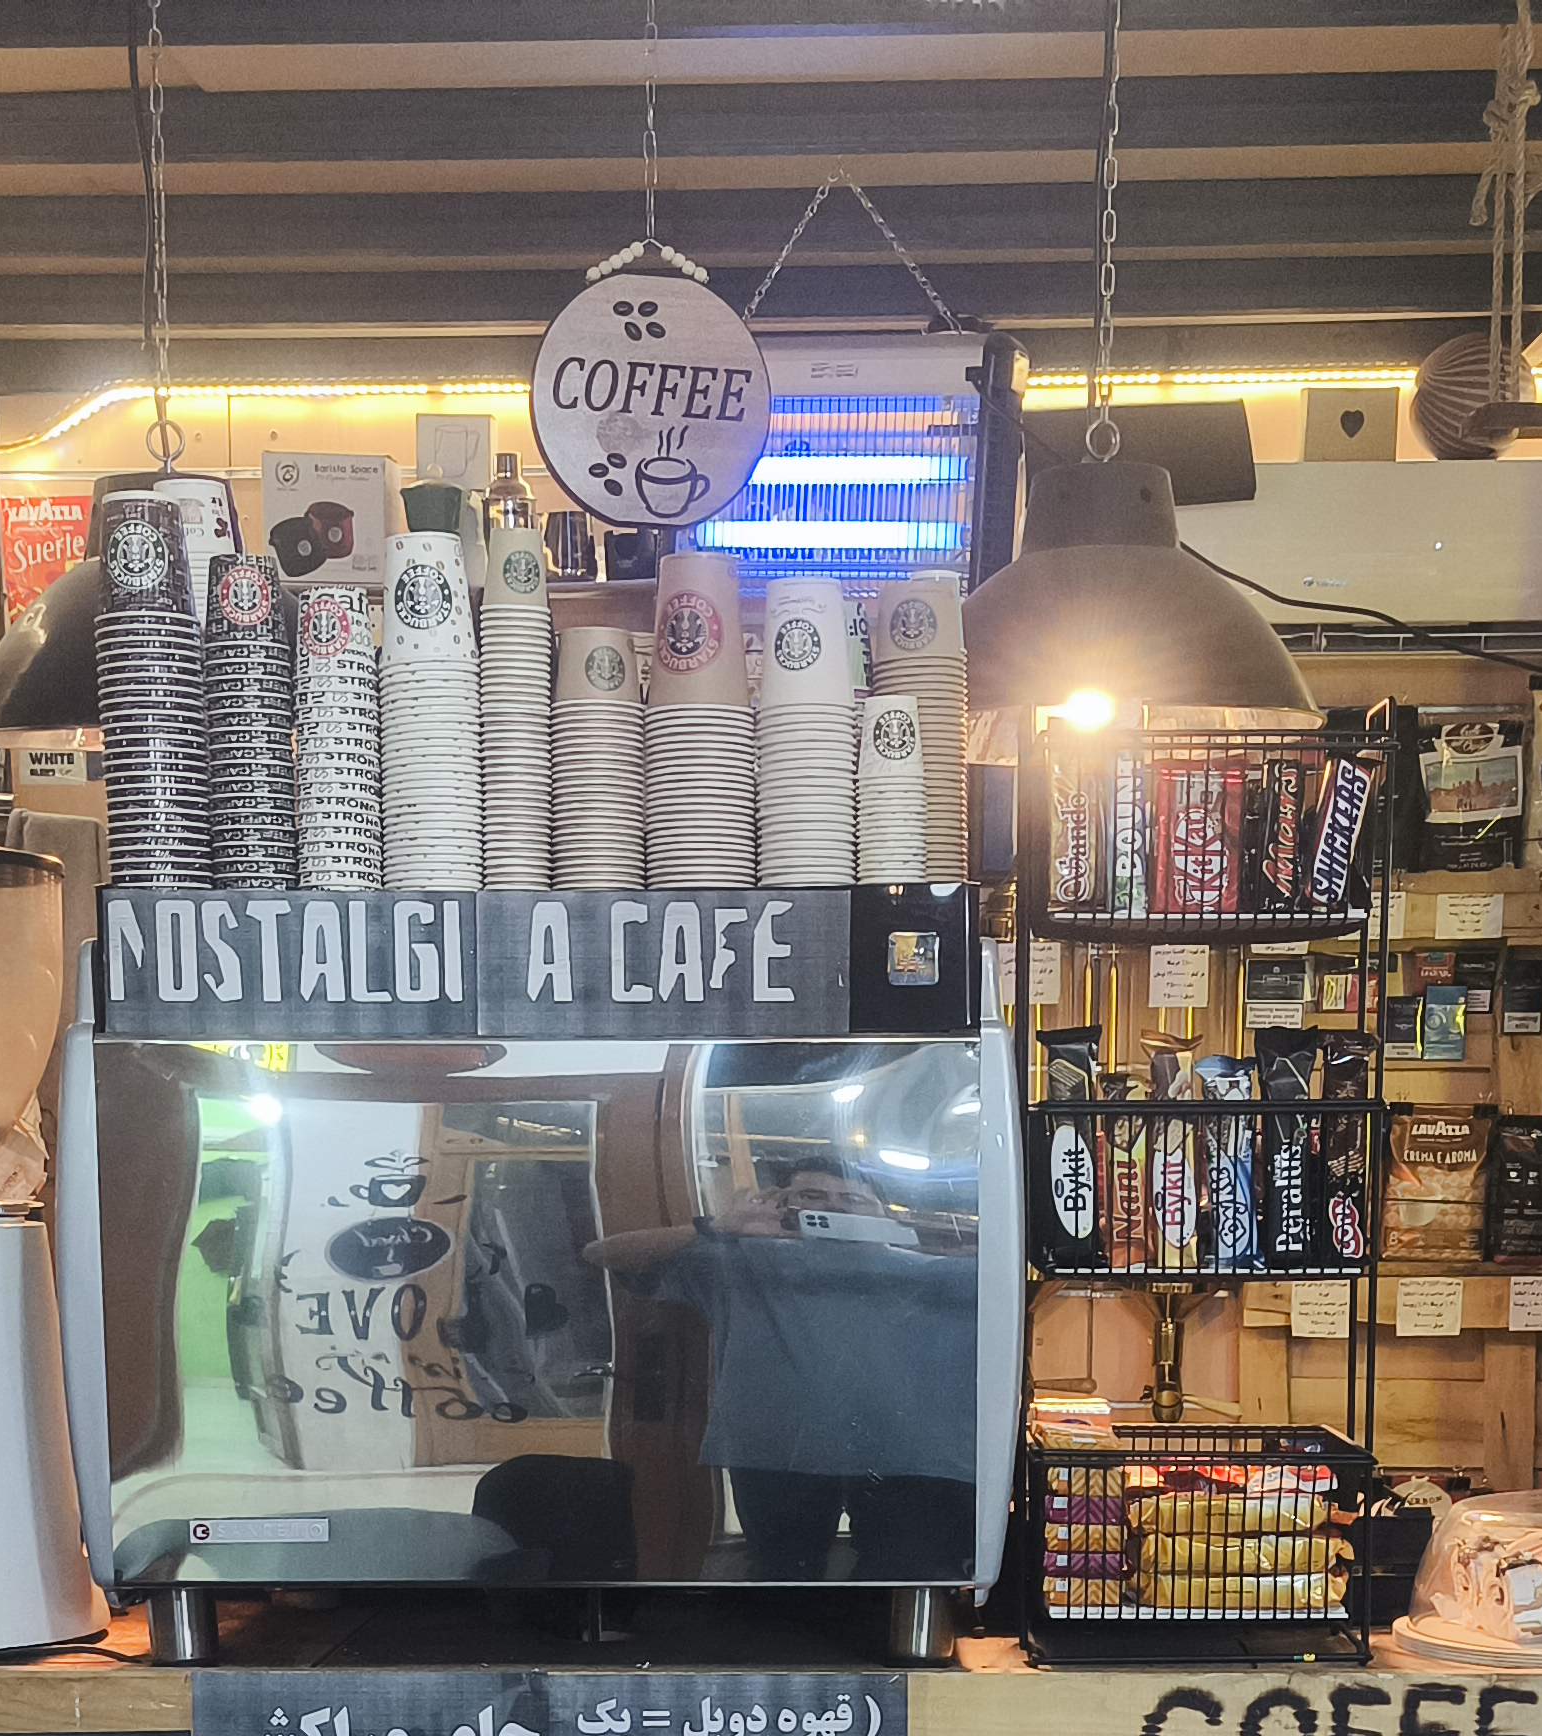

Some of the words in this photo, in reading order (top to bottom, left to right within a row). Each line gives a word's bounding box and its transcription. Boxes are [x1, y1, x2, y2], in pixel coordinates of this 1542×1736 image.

[552, 356, 753, 423] COFFEE
[315, 464, 346, 473] Barista
[350, 465, 378, 474] Space
[114, 521, 158, 542] COFFEE
[13, 532, 86, 573] Suerte
[401, 565, 445, 585] COFFEE
[29, 752, 74, 766] WHITE
[1311, 759, 1373, 904] SNICKERS
[611, 899, 795, 1002] CAFE
[1411, 1121, 1470, 1136] LAVAZZA
[1403, 1149, 1434, 1163] CREMA
[1436, 1152, 1442, 1164] E
[1445, 1149, 1477, 1164] AROMA
[1061, 1146, 1092, 1213] Bykit
[1162, 1159, 1192, 1227] Bykit
